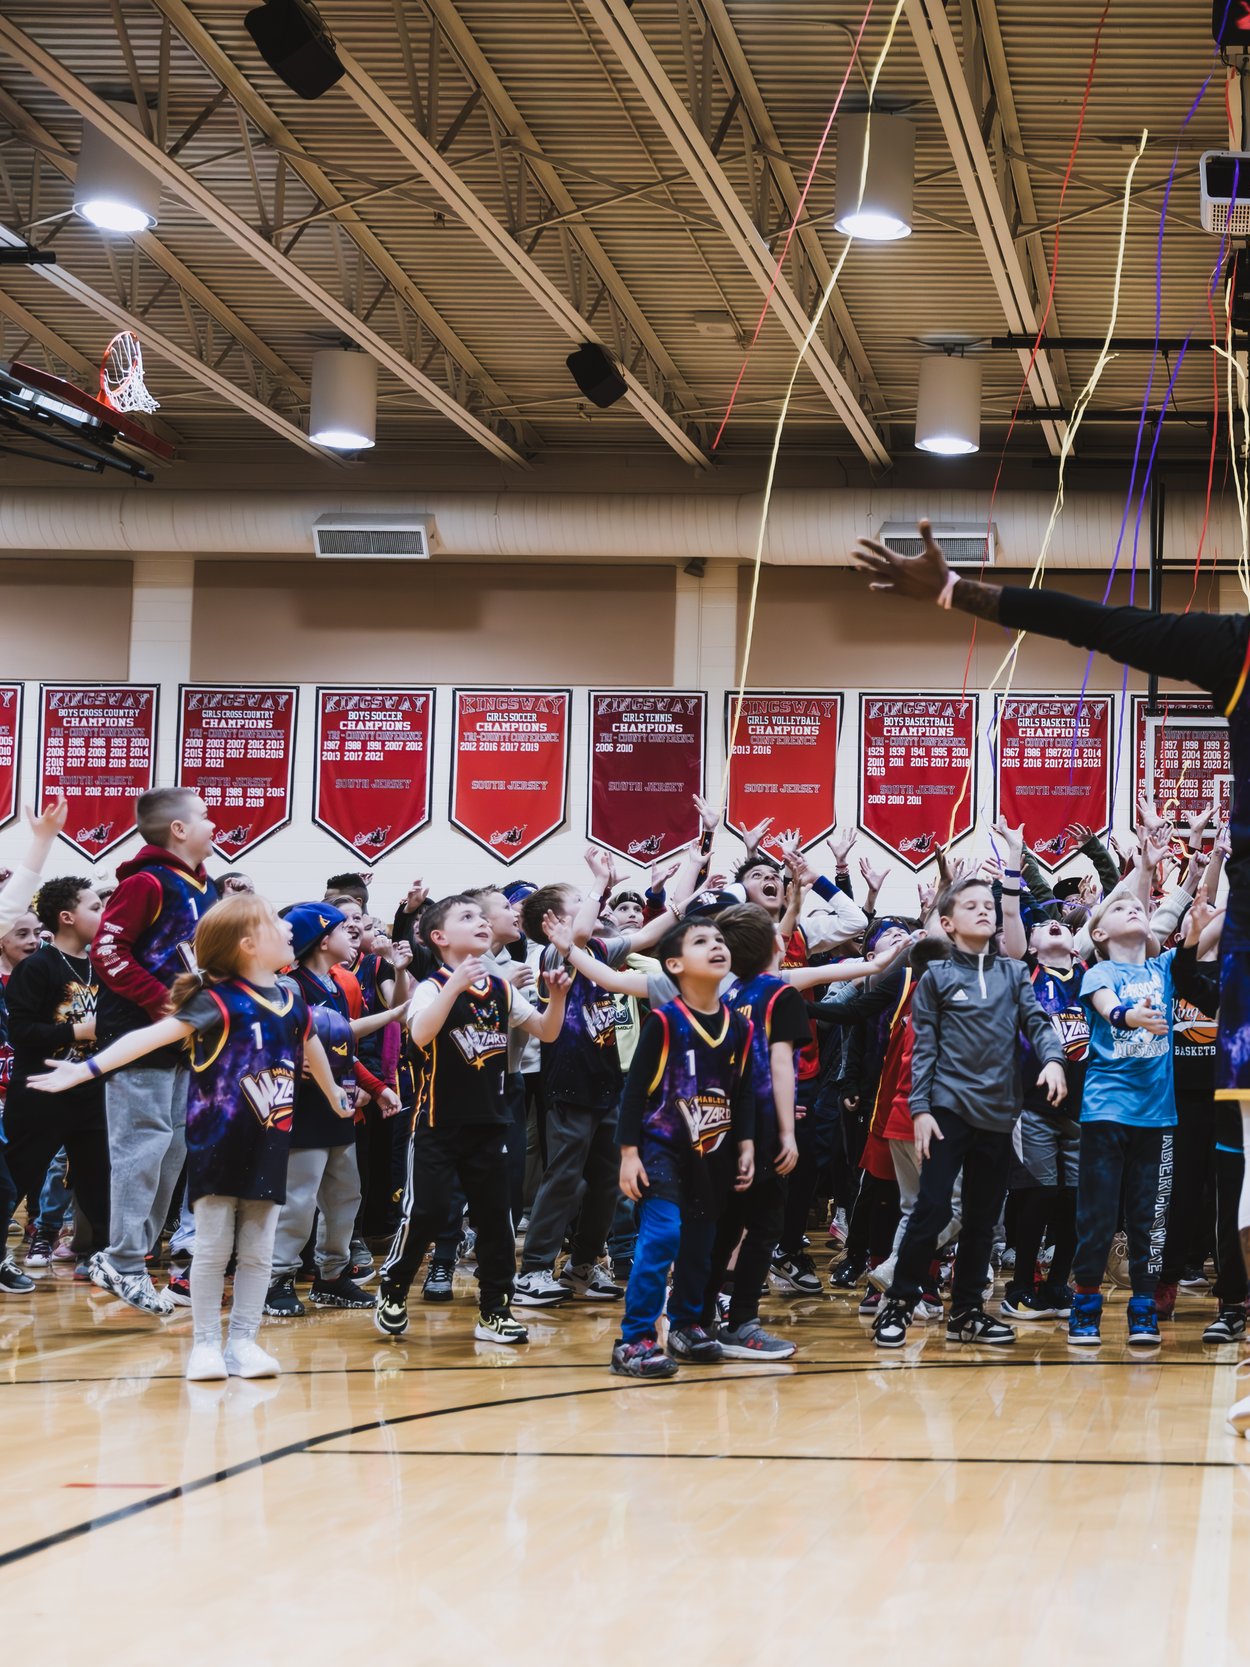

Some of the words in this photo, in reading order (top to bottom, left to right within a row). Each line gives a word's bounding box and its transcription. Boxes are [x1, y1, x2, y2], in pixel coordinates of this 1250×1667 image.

[49, 692, 150, 709] KINGSWAY
[188, 694, 288, 711] KINGSWAY
[325, 696, 426, 713] KINGSWAY
[462, 697, 563, 714] KINGSWAY
[598, 698, 698, 715] KINGSWAY
[735, 701, 834, 718] KINGSWAY
[869, 702, 969, 719] KINGSWAY
[1004, 703, 1105, 720] KINGSWAY
[348, 712, 370, 720] BOYS
[371, 712, 402, 720] SOCCER
[487, 713, 508, 721] GIRLS
[509, 713, 537, 721] SOCCER
[623, 714, 644, 722] GIRLS
[646, 714, 672, 722] TENNIS
[747, 716, 768, 725] GIRLS
[772, 716, 820, 725] VOLLEYBALL
[63, 718, 134, 726] CHAMPIONS
[203, 719, 273, 728] CHAMPIONS
[340, 722, 411, 730] CHAMPIONS
[884, 718, 904, 726] BOYS
[905, 718, 954, 726] BASKETBALL
[1018, 719, 1039, 727] GIRLS
[476, 723, 547, 731] CHAMPIONS
[612, 724, 683, 732] CHAMPIONS
[748, 726, 819, 735] CHAMPIONS
[884, 727, 954, 736] CHAMPIONS
[206, 739, 224, 748] 2003
[227, 739, 245, 748] 2007
[248, 739, 264, 748] 2012
[266, 739, 284, 748] 2013
[385, 742, 403, 750] 2007
[406, 742, 422, 750] 2012
[460, 742, 476, 751] 2012
[479, 742, 498, 751] 2016
[500, 742, 518, 751] 2017
[520, 742, 539, 751] 2019
[110, 748, 126, 756] 2012
[130, 748, 148, 756] 2014
[185, 749, 203, 758] 2015
[206, 749, 224, 758] 2016
[226, 749, 244, 758] 2017
[266, 749, 283, 758] 2019
[732, 746, 750, 754] 2013
[753, 746, 771, 754] 2016
[1003, 748, 1019, 757] 1967
[1083, 748, 1101, 757] 2014
[322, 752, 340, 760] 2013
[344, 752, 363, 760] 2017
[365, 752, 383, 760] 2021
[1182, 751, 1200, 759] 2004
[67, 758, 85, 767] 2017
[108, 758, 126, 767] 2019
[130, 758, 148, 767] 2020
[205, 759, 224, 767] 2021
[889, 758, 904, 767] 2011
[911, 758, 928, 767] 2015
[931, 758, 949, 767] 2017
[1002, 759, 1020, 767] 2015
[1023, 759, 1042, 767] 2016
[1045, 759, 1062, 767] 2017
[1083, 759, 1101, 767] 2021
[1203, 760, 1221, 768] 2020
[45, 767, 64, 775] 2021
[867, 767, 885, 776] 2019
[472, 781, 505, 790] SOUTH
[507, 781, 548, 790] JERSEY
[1160, 779, 1176, 788] 2001
[1180, 779, 1198, 788] 2003
[66, 787, 81, 795] 2011
[85, 787, 101, 795] 2012
[104, 787, 122, 795] 2017
[267, 788, 284, 796] 2015
[1180, 789, 1198, 797] 2020
[204, 797, 221, 807] 2017
[246, 797, 264, 807] 2019
[888, 796, 904, 804] 2010
[907, 796, 921, 804] 2011
[189, 898, 198, 920] 1
[1046, 980, 1054, 999] 1
[251, 1022, 262, 1050] 1
[1175, 1046, 1216, 1056] BASKETB
[686, 1049, 695, 1076] 1
